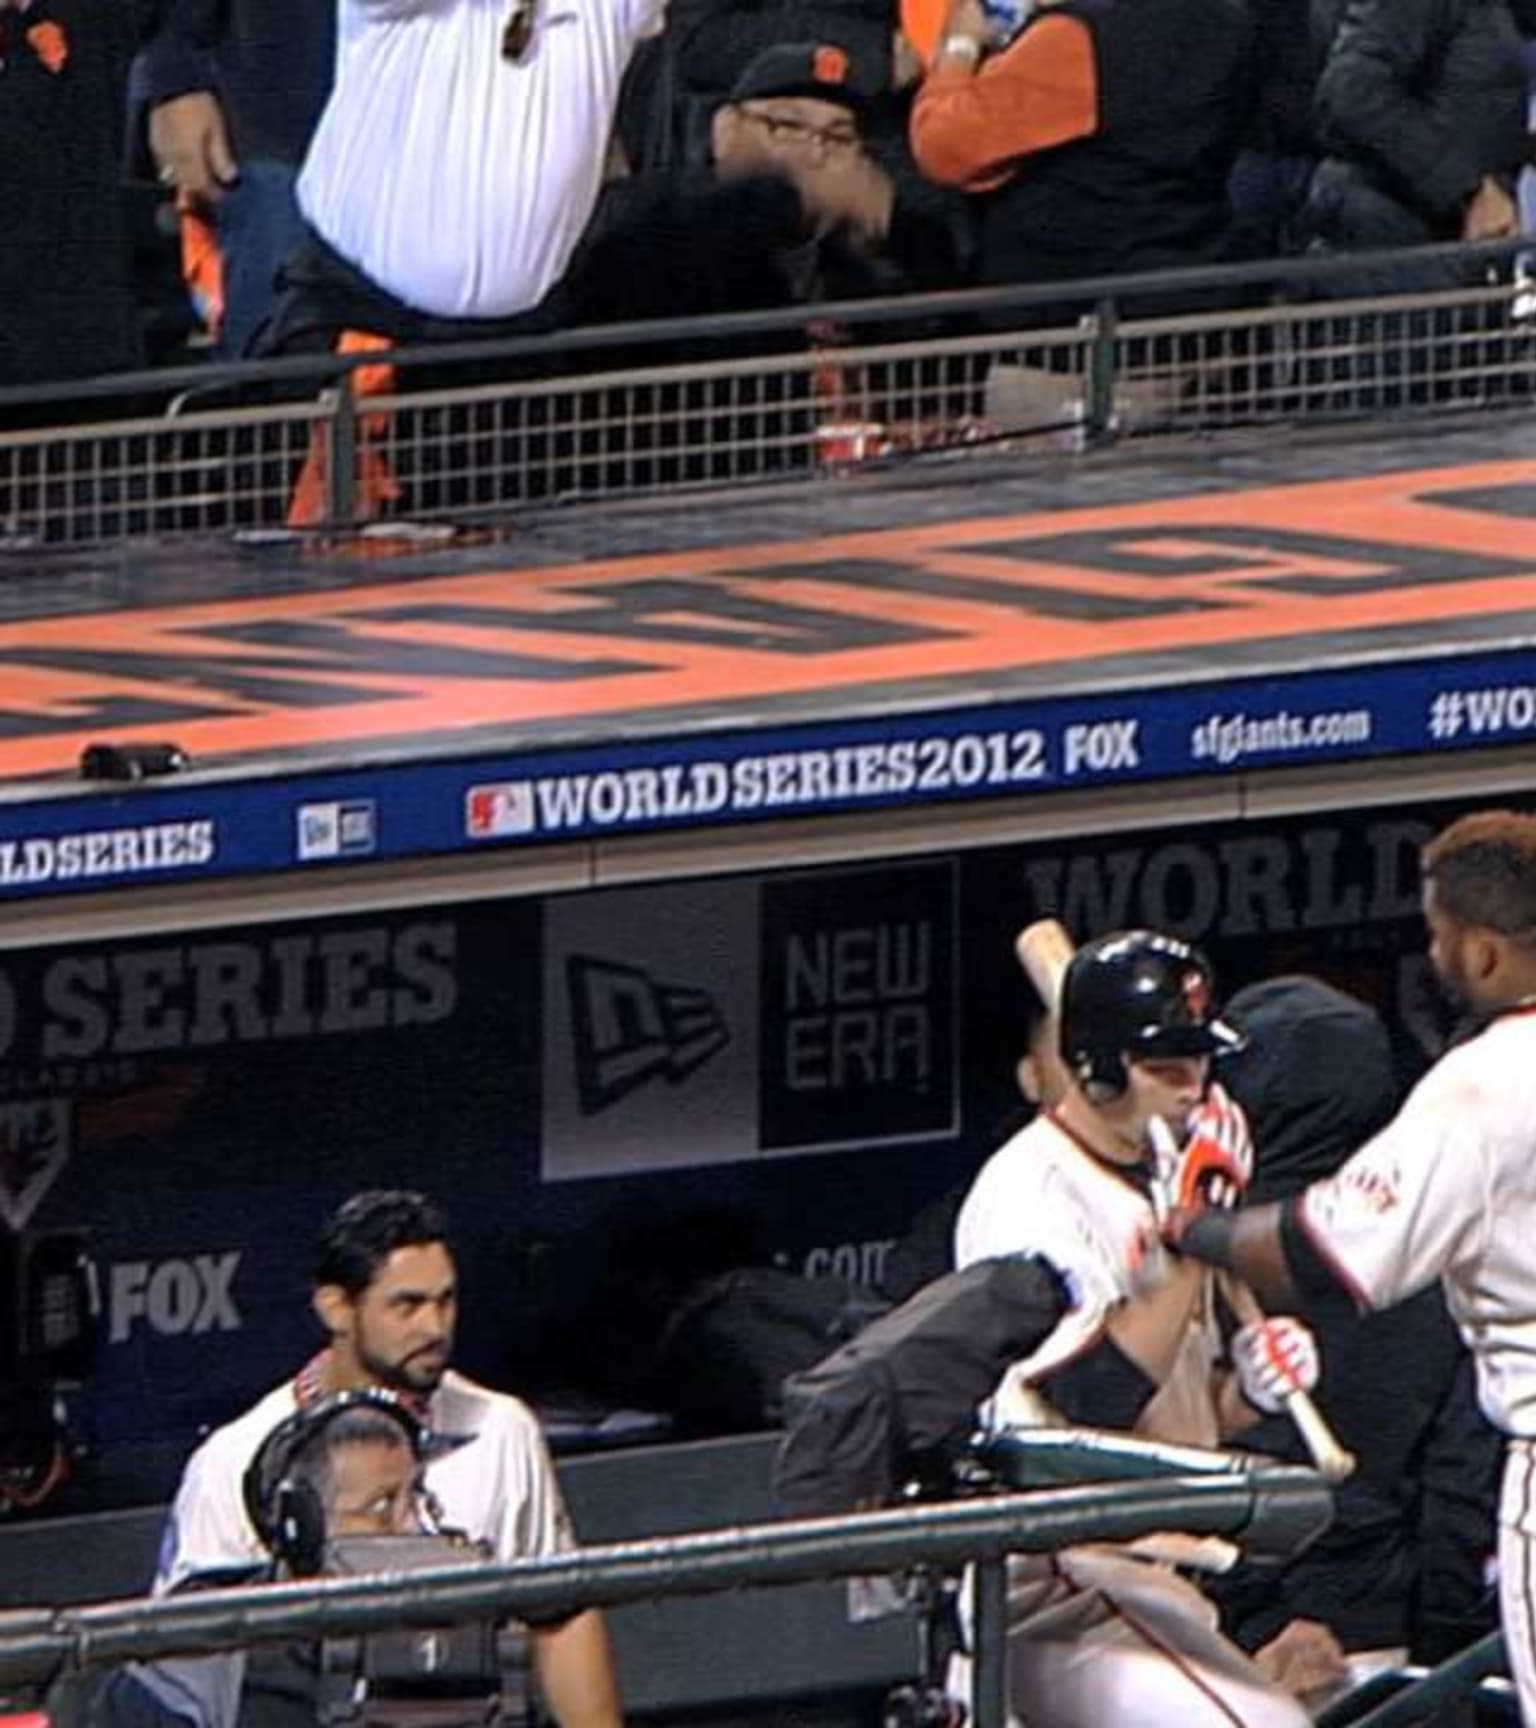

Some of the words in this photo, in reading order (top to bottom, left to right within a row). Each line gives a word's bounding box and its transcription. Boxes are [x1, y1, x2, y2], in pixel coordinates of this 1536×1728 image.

[1064, 720, 1139, 775] FOX
[1191, 707, 1371, 764] sfgiants.com
[41, 920, 459, 1058] SERIES
[784, 920, 932, 1010] NEW
[784, 1004, 931, 1092] ERA
[107, 1250, 243, 1344] FOX
